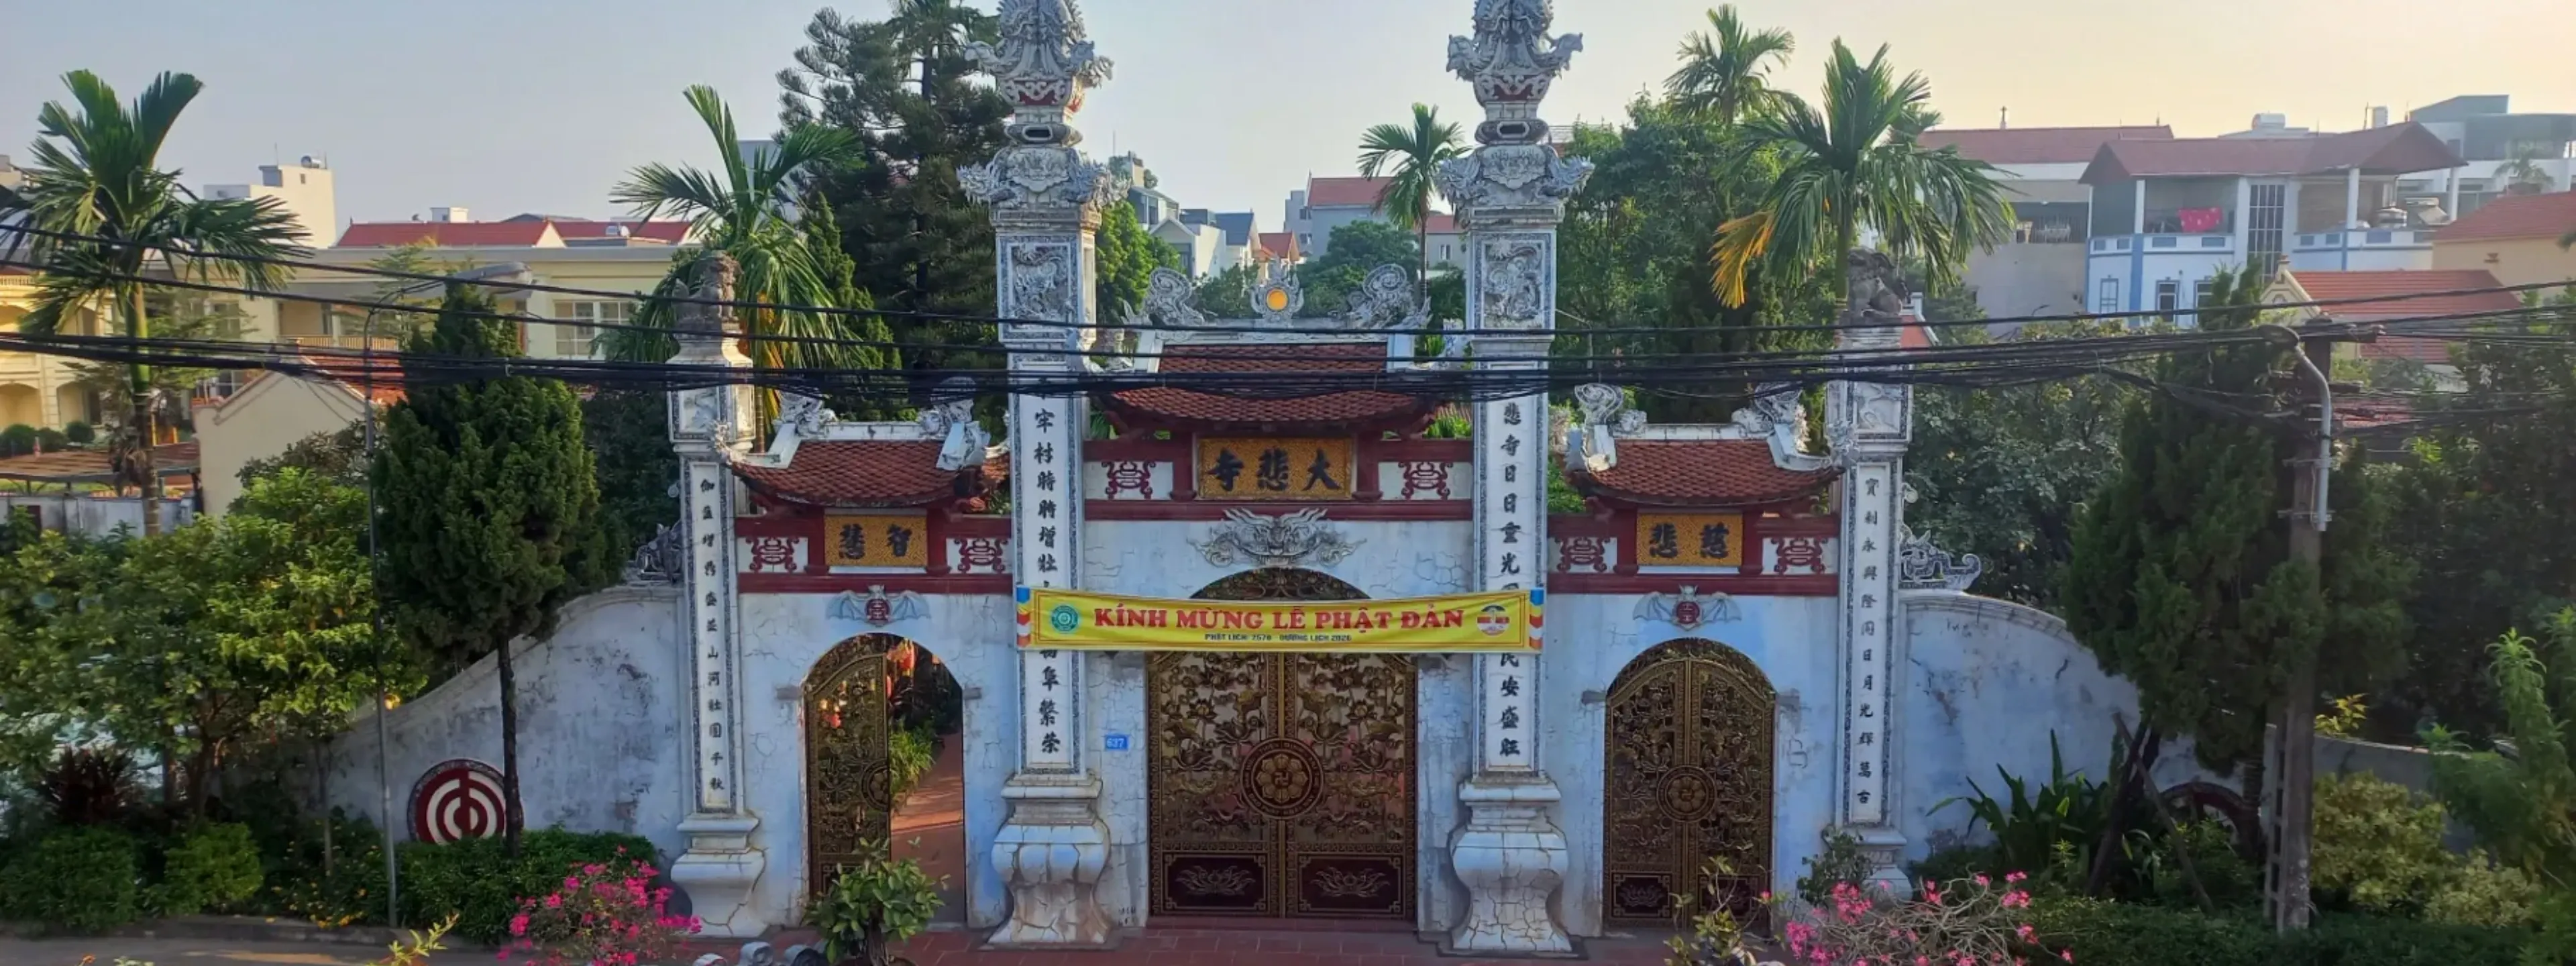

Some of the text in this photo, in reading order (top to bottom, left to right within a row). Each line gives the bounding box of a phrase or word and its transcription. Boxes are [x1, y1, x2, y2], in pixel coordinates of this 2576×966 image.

[1094, 602, 1167, 628] KÍNH
[1175, 607, 1263, 629] MỪNG
[1272, 605, 1305, 629] LỄ
[1315, 606, 1393, 633] PHẬT
[1401, 603, 1464, 629] ĐẢN
